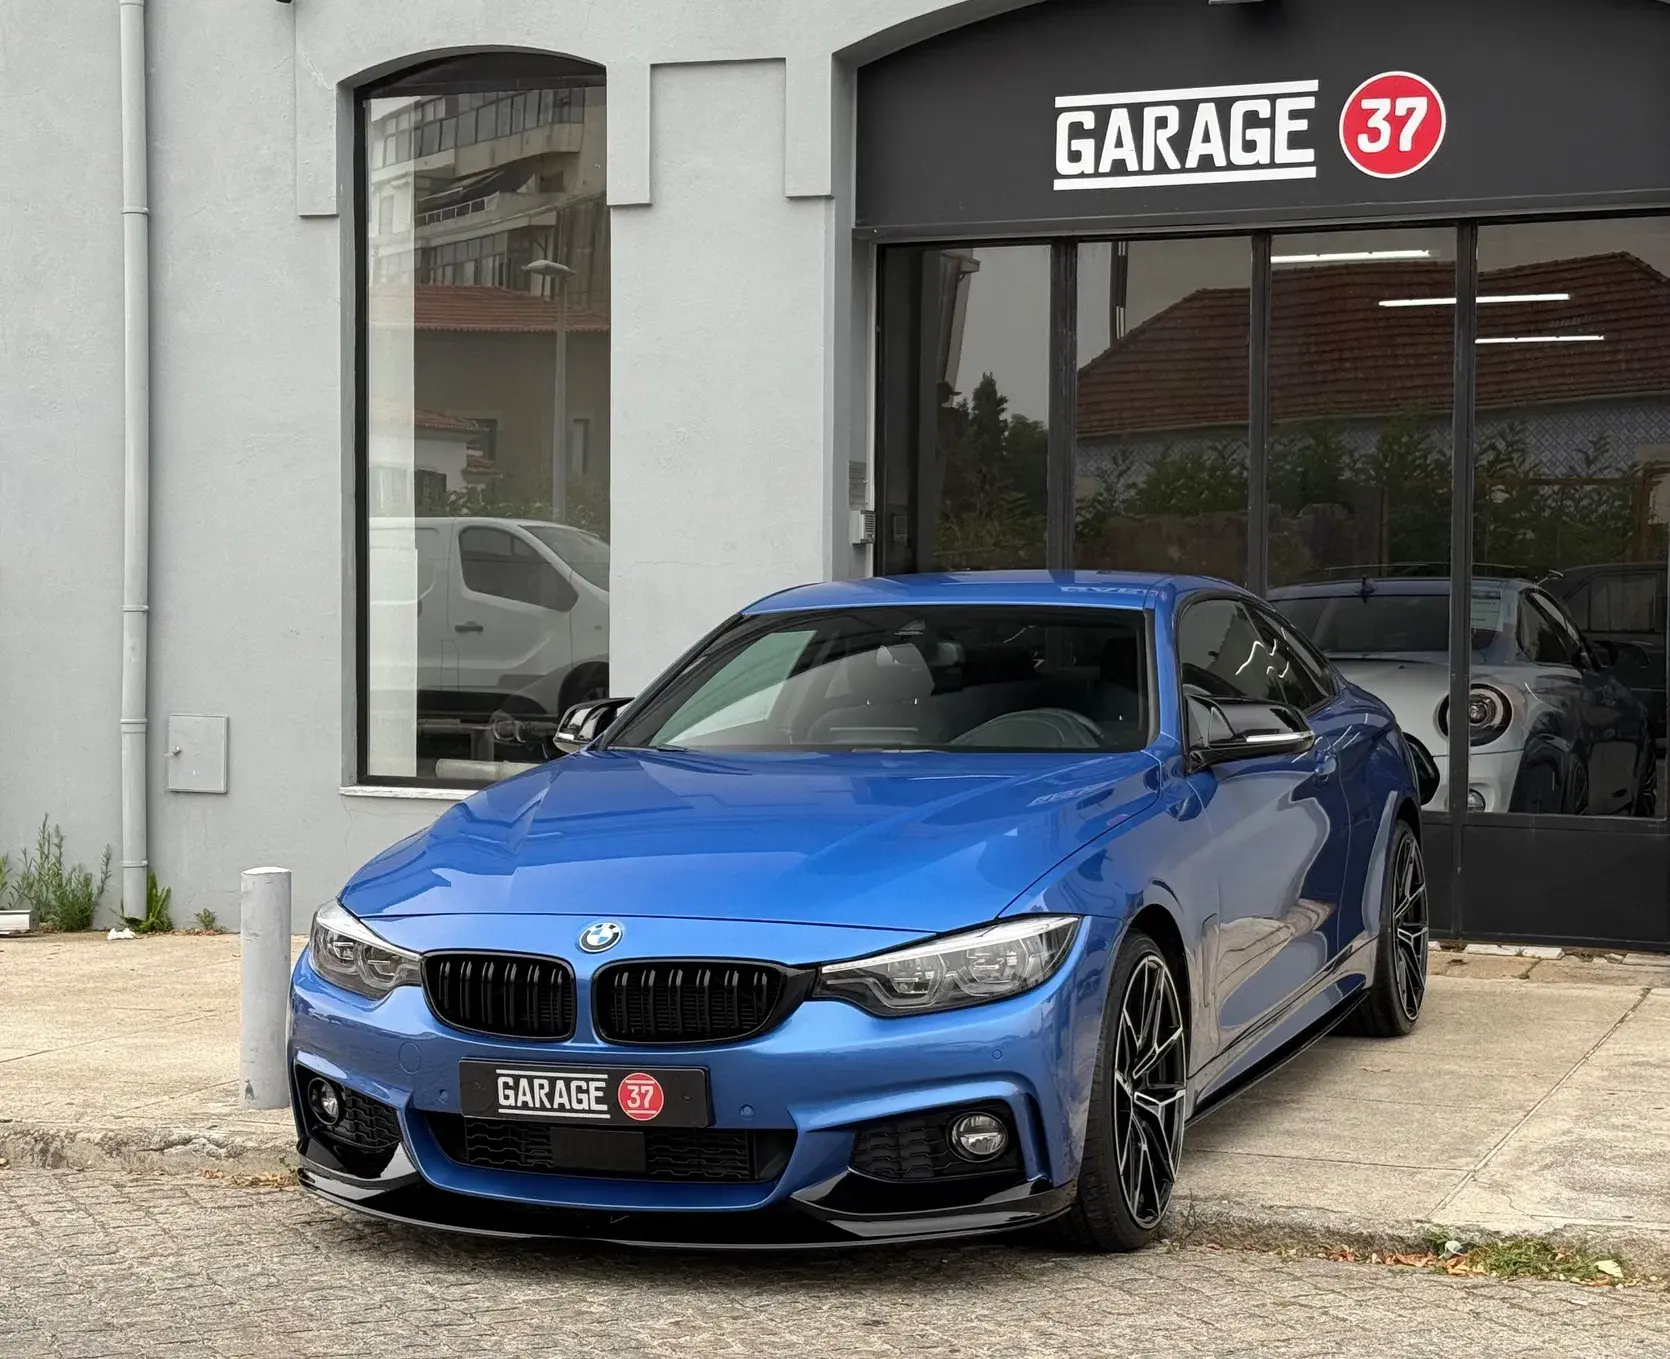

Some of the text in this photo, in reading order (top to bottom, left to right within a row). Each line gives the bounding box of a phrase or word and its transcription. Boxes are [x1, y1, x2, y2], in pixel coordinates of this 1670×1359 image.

[1056, 97, 1427, 175] GARAGE 37
[498, 1077, 654, 1111] GARAGE 37
